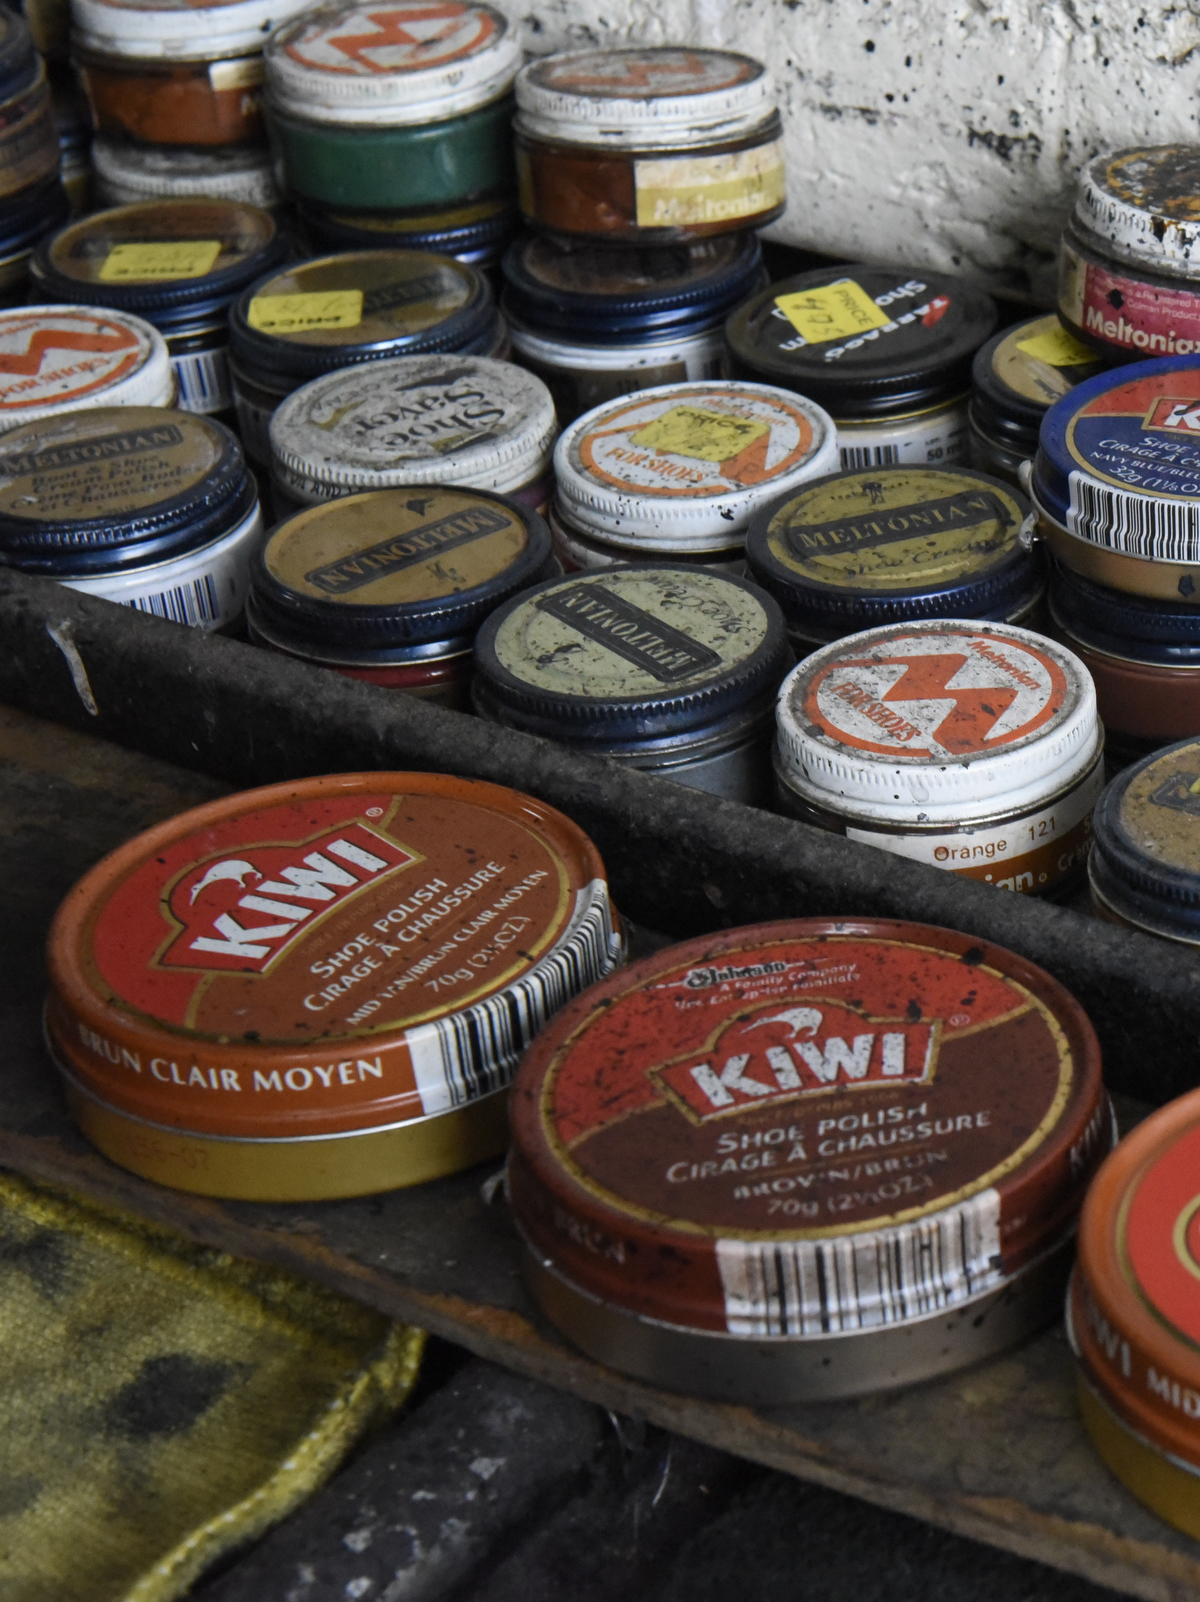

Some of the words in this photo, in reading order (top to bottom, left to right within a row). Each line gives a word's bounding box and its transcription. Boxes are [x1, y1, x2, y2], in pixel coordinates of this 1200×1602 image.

[834, 288, 874, 327] PRICE
[874, 279, 927, 308] Sho
[354, 389, 487, 437] Saver
[379, 406, 507, 447] Shoe
[1, 428, 176, 477] MELTONIAN
[605, 446, 647, 470] FOR
[1089, 450, 1130, 465] NAVY
[1098, 438, 1161, 460] CIRAGE
[1138, 436, 1192, 455] SHOE
[1109, 464, 1144, 484] 32g
[796, 496, 990, 549] MELTONIAN
[324, 511, 498, 588] MELTONIAN
[564, 590, 701, 677] MELTONIAN
[966, 640, 1042, 692] Meltonian
[859, 700, 924, 742] SHOES
[933, 838, 1008, 863] Orange
[1028, 815, 1057, 842] 121
[188, 838, 390, 960] KIWI
[303, 955, 384, 1013] CIRAGE
[397, 860, 507, 943] CHAUSSURE
[309, 931, 378, 980] SHOE
[372, 877, 449, 934] POLISH
[346, 999, 382, 1026] MID
[453, 908, 500, 943] CLAIR
[493, 869, 550, 911] MOYEN
[423, 967, 476, 993] 70g
[150, 1058, 242, 1093] CLAIR
[252, 1056, 384, 1093] MOYEN
[689, 1032, 907, 1109] KIWI
[665, 1151, 779, 1184] CIRAGE
[816, 1111, 993, 1157] CHAUSSURE
[716, 1125, 806, 1155] SHOE
[816, 1102, 928, 1136] POLISH
